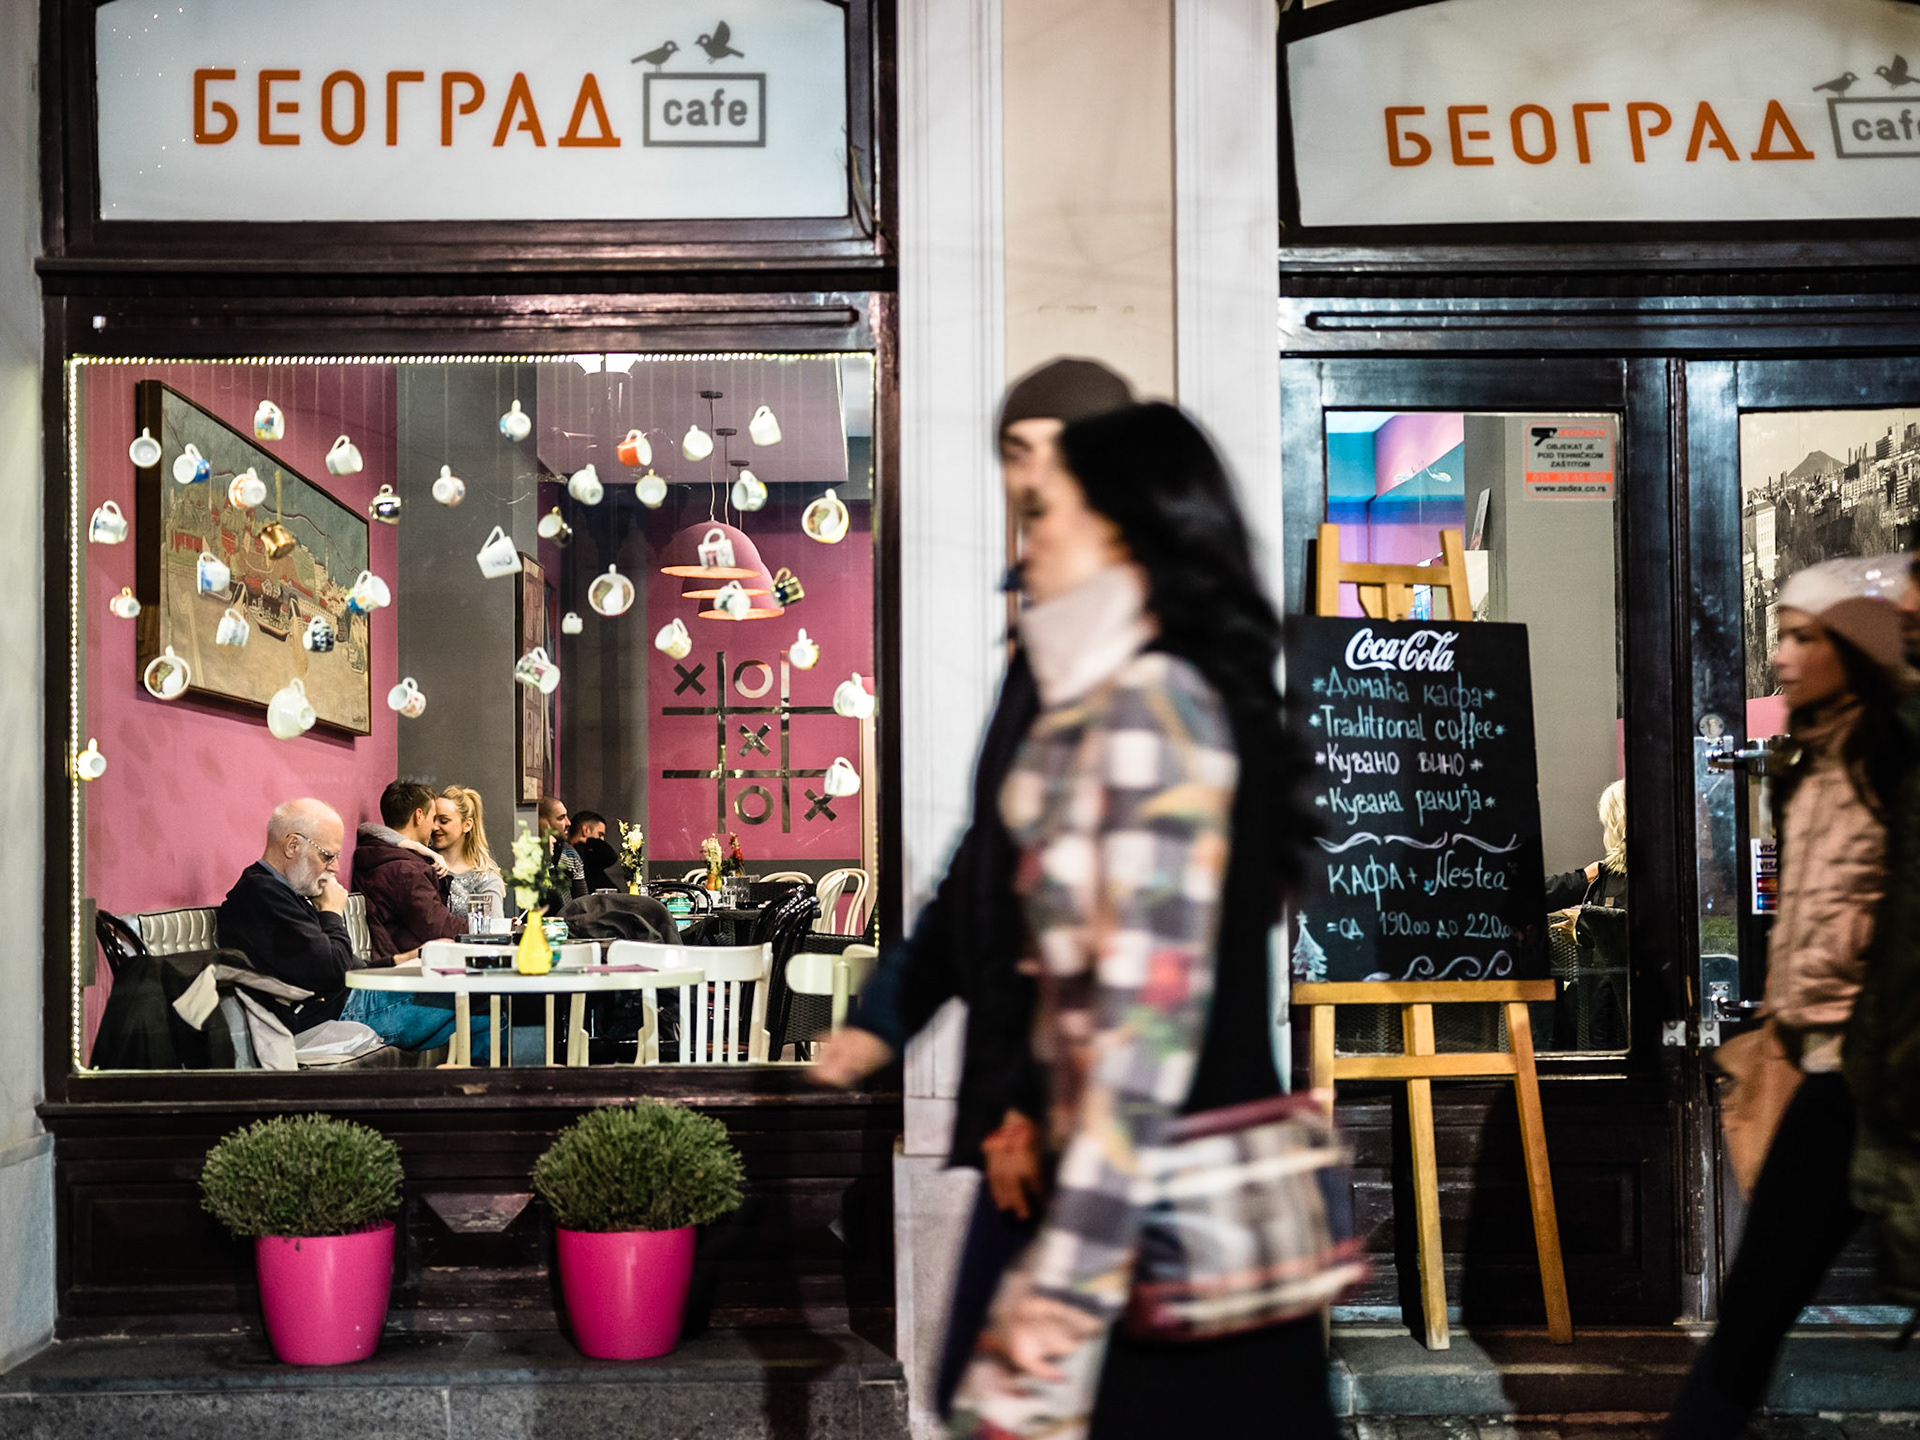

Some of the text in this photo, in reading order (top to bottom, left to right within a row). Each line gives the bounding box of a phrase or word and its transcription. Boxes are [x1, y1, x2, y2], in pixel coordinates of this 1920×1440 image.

[193, 68, 749, 148] БЕОГРАД cafe
[1384, 99, 1816, 168] БЕОГРАД
[1550, 460, 1591, 468] ZAŠTITOM
[1557, 451, 1604, 459] TEHNIČKOM
[1319, 704, 1496, 750] Traditional coffee
